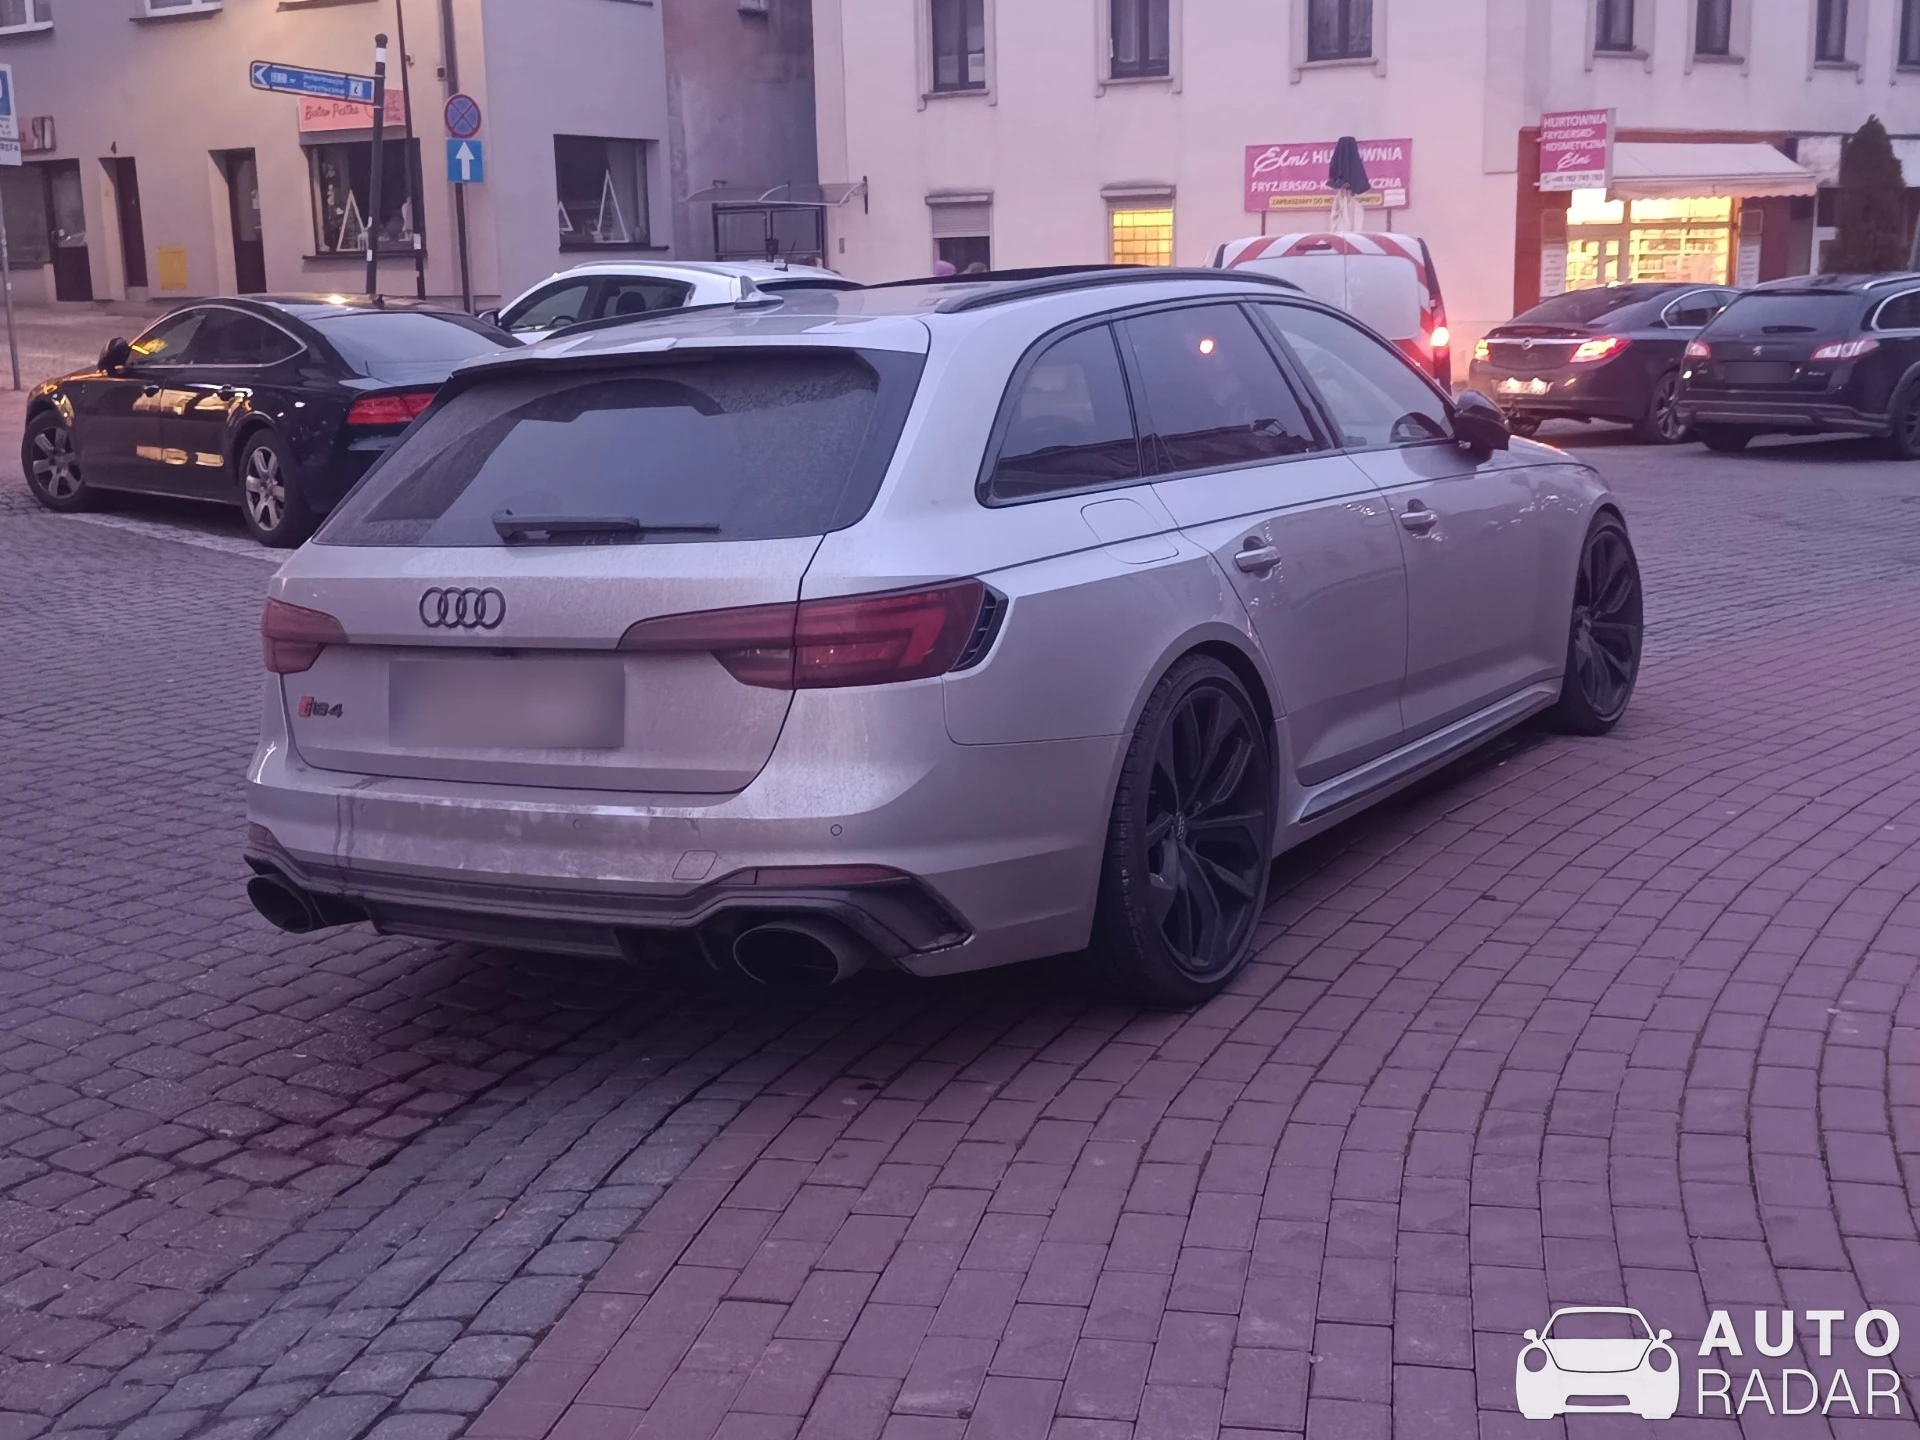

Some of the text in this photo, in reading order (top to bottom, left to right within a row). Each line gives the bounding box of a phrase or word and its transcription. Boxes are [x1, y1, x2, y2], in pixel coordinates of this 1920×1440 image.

[1543, 114, 1607, 128] HURTOWNIA
[1252, 147, 1402, 178] Elmi HUWNIA
